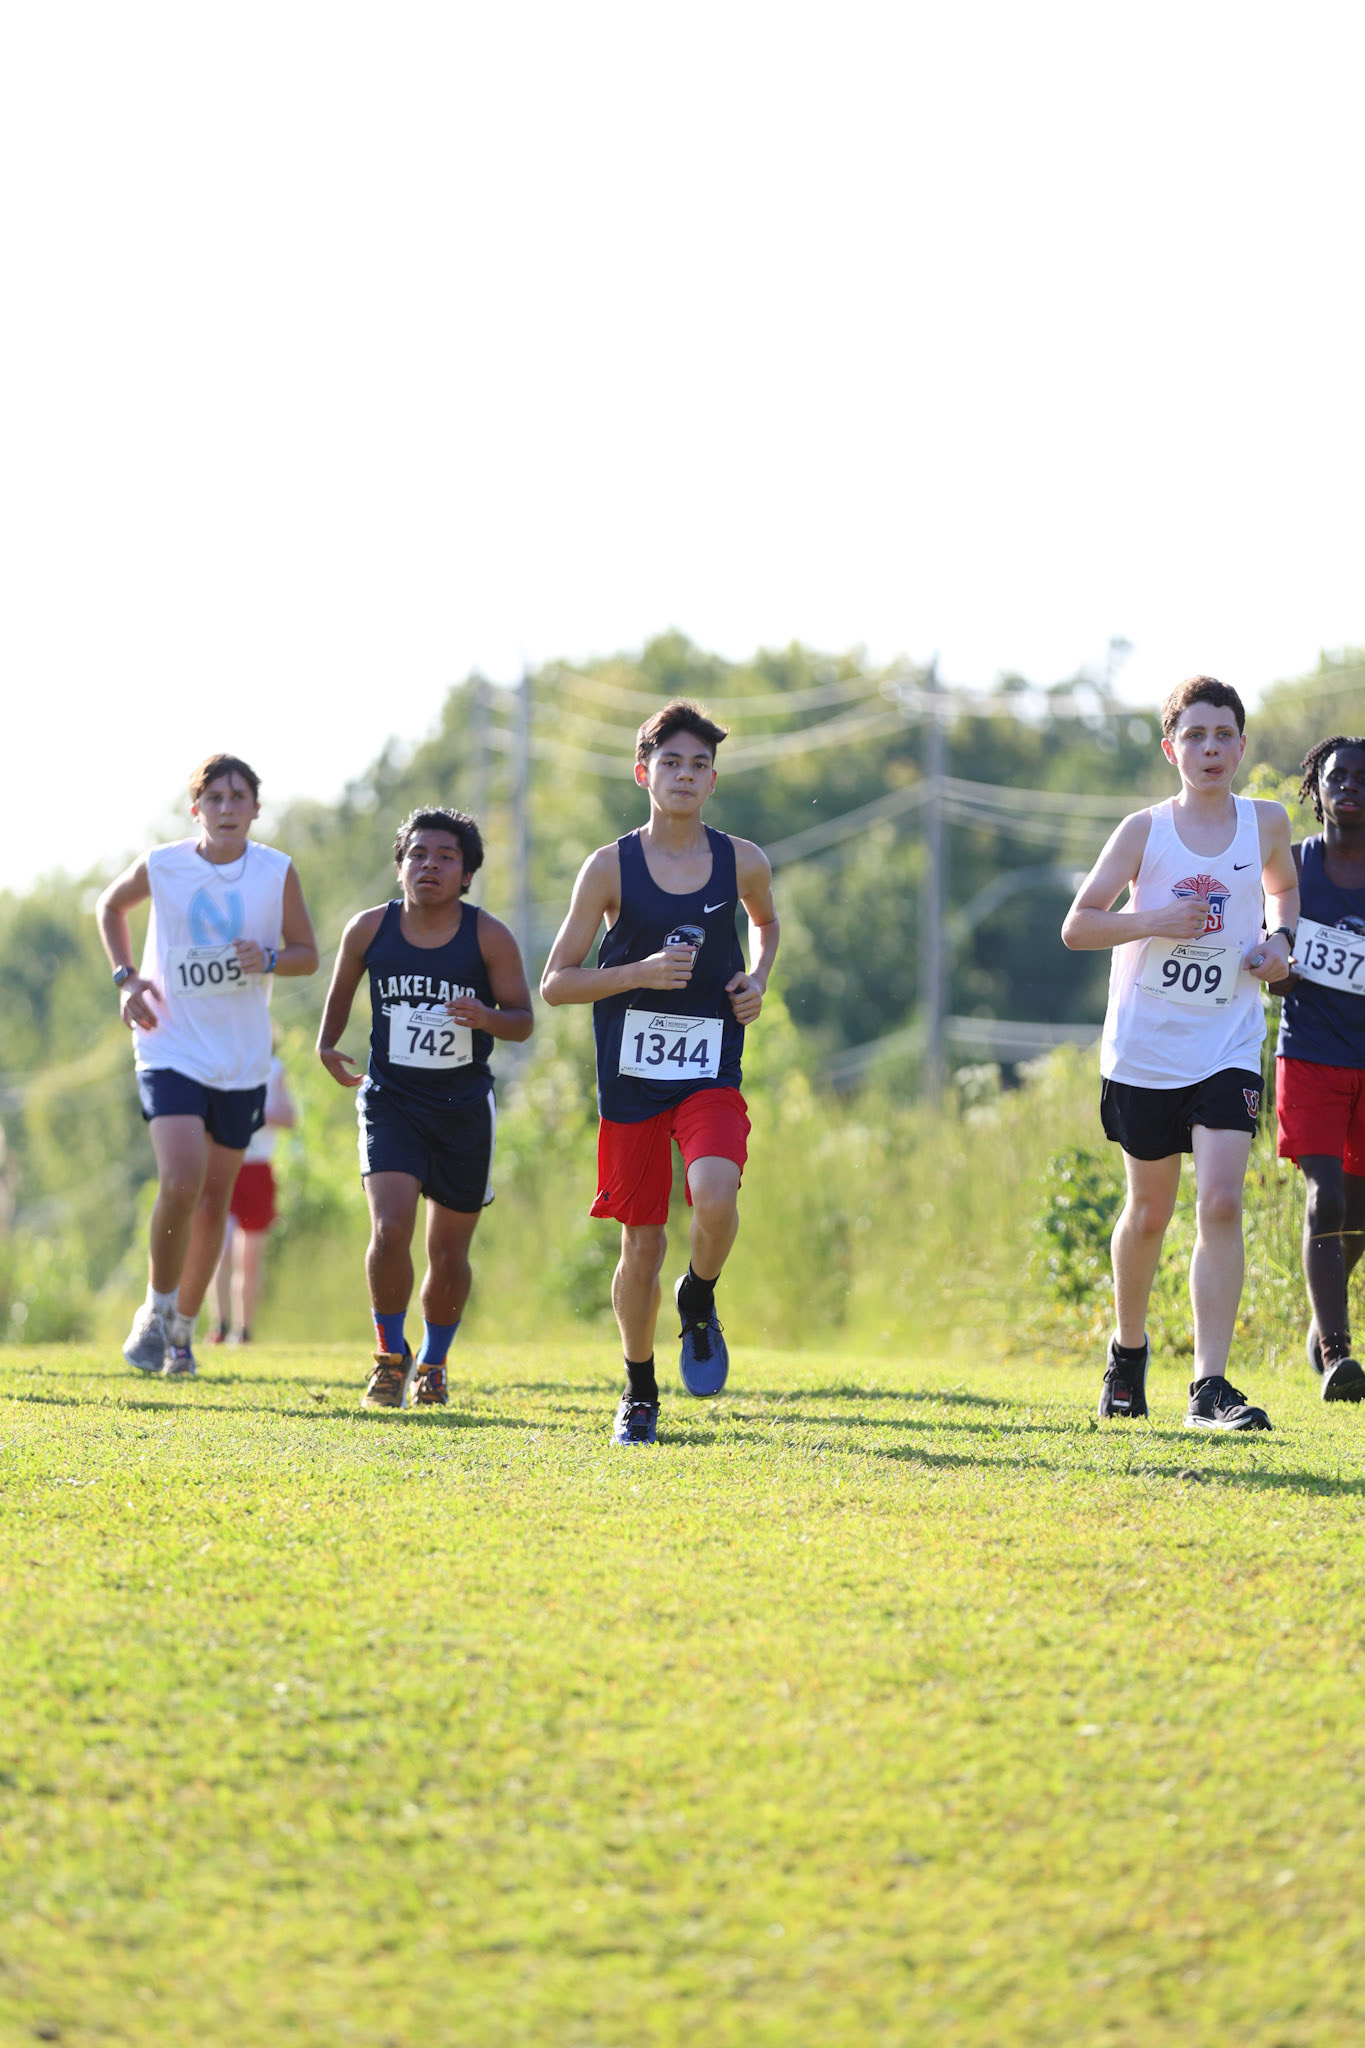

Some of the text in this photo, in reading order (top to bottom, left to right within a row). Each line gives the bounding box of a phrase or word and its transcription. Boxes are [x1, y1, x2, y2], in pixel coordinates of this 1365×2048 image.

[189, 888, 244, 945] N
[178, 957, 242, 987] 1005
[1162, 959, 1222, 994] 909
[1304, 939, 1365, 979] 1337
[406, 1025, 456, 1057] 742
[633, 1031, 710, 1068] 1344
[1242, 1087, 1260, 1119] U
